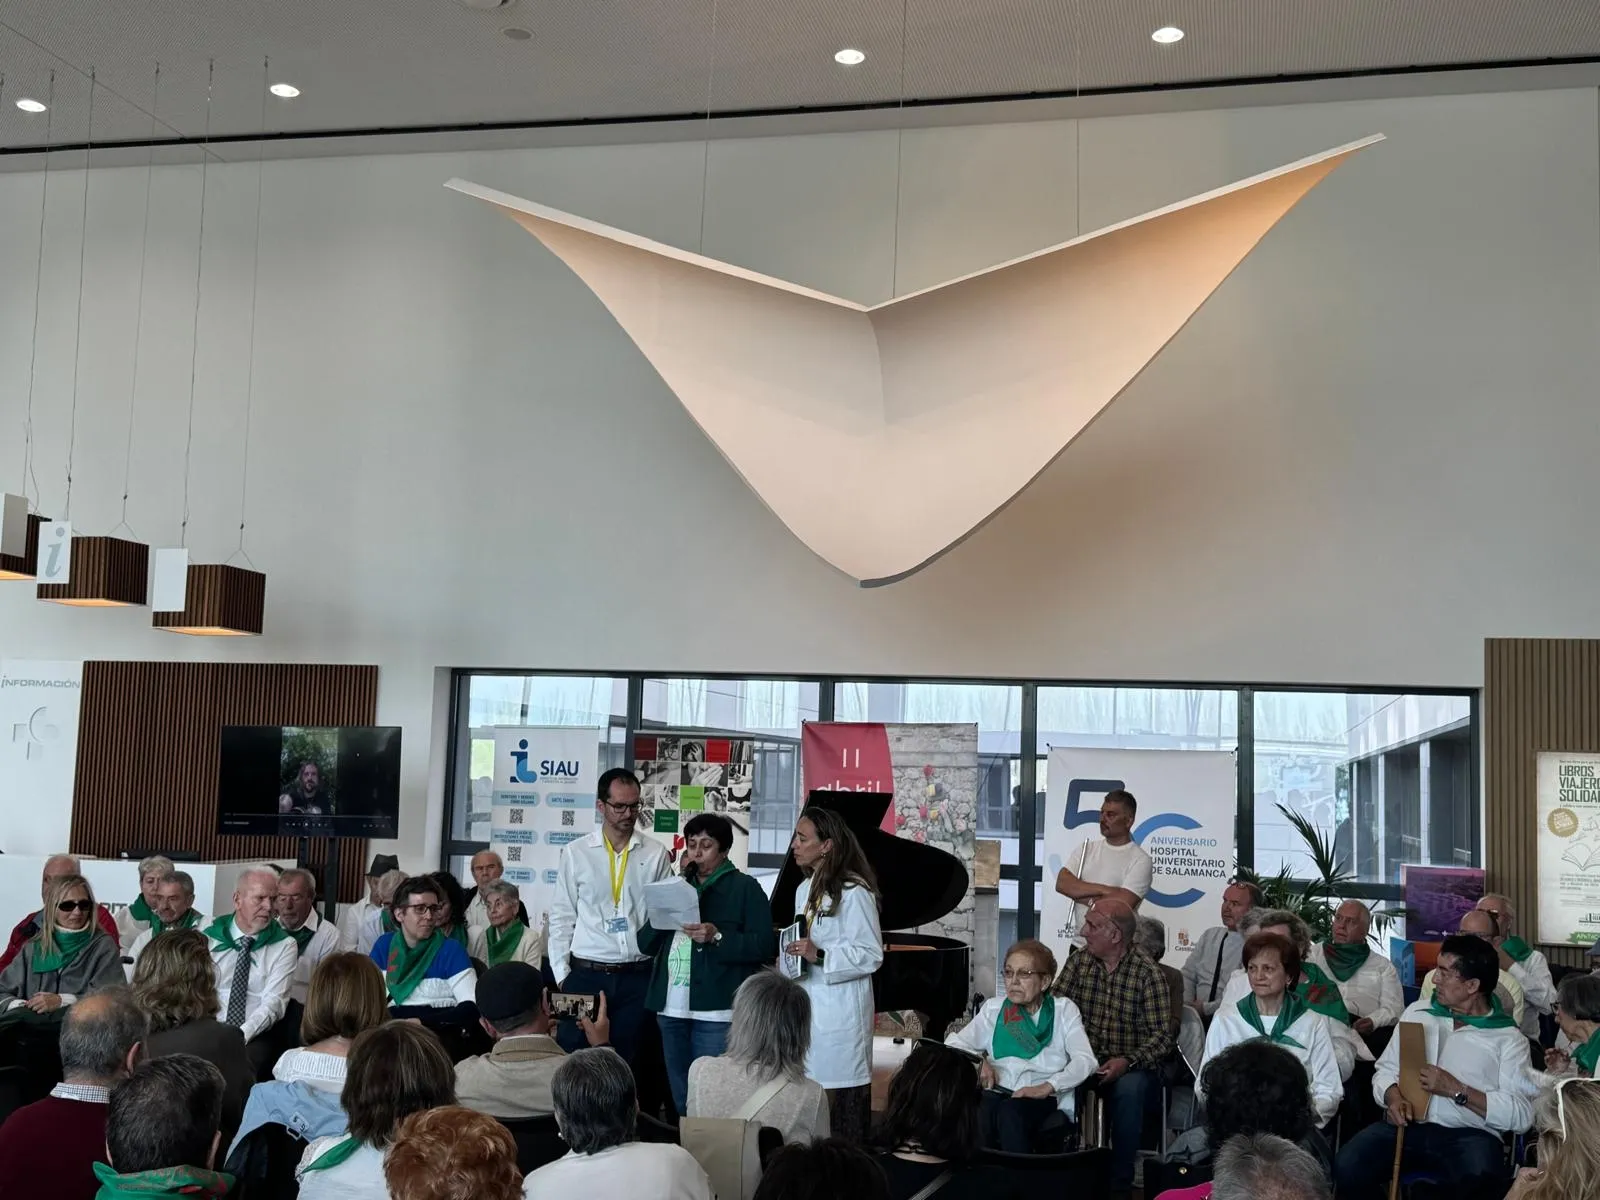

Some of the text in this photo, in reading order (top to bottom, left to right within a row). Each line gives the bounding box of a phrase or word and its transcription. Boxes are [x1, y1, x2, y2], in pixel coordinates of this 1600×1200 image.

[540, 760, 579, 776] SIAU
[1559, 765, 1594, 777] LIBROS
[1150, 836, 1217, 847] ANIVERSARIO
[1150, 847, 1198, 857] HOSPITAL
[1165, 867, 1226, 879] SALAMANCA
